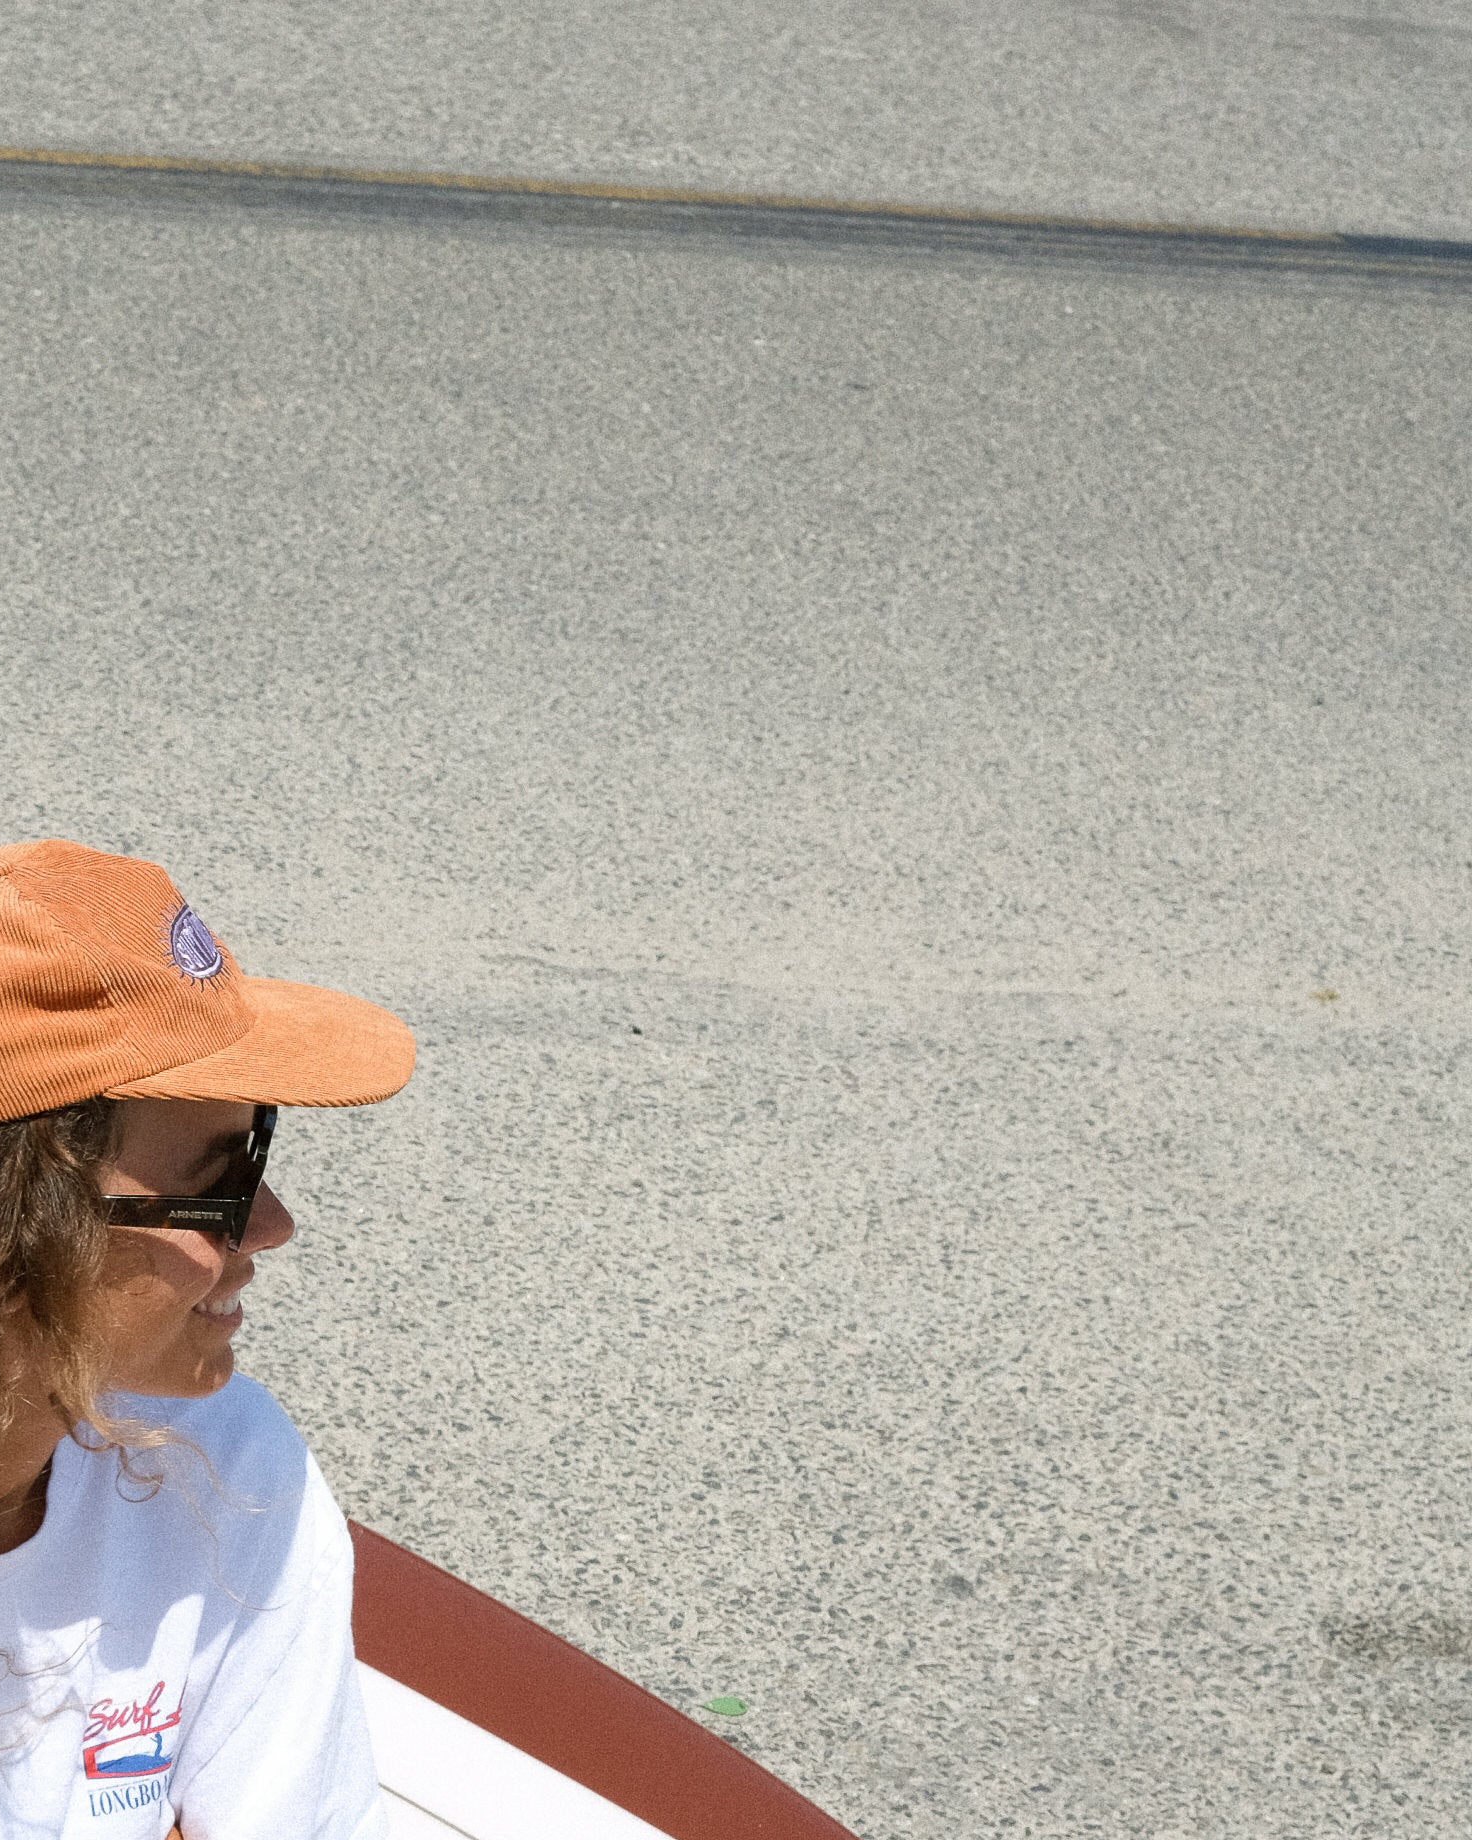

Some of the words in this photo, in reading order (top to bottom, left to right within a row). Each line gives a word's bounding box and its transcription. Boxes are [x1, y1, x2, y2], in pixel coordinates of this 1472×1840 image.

[168, 1210, 223, 1220] ARNETTE
[83, 1681, 165, 1742] Surf
[89, 1777, 168, 1817] LONGBO
